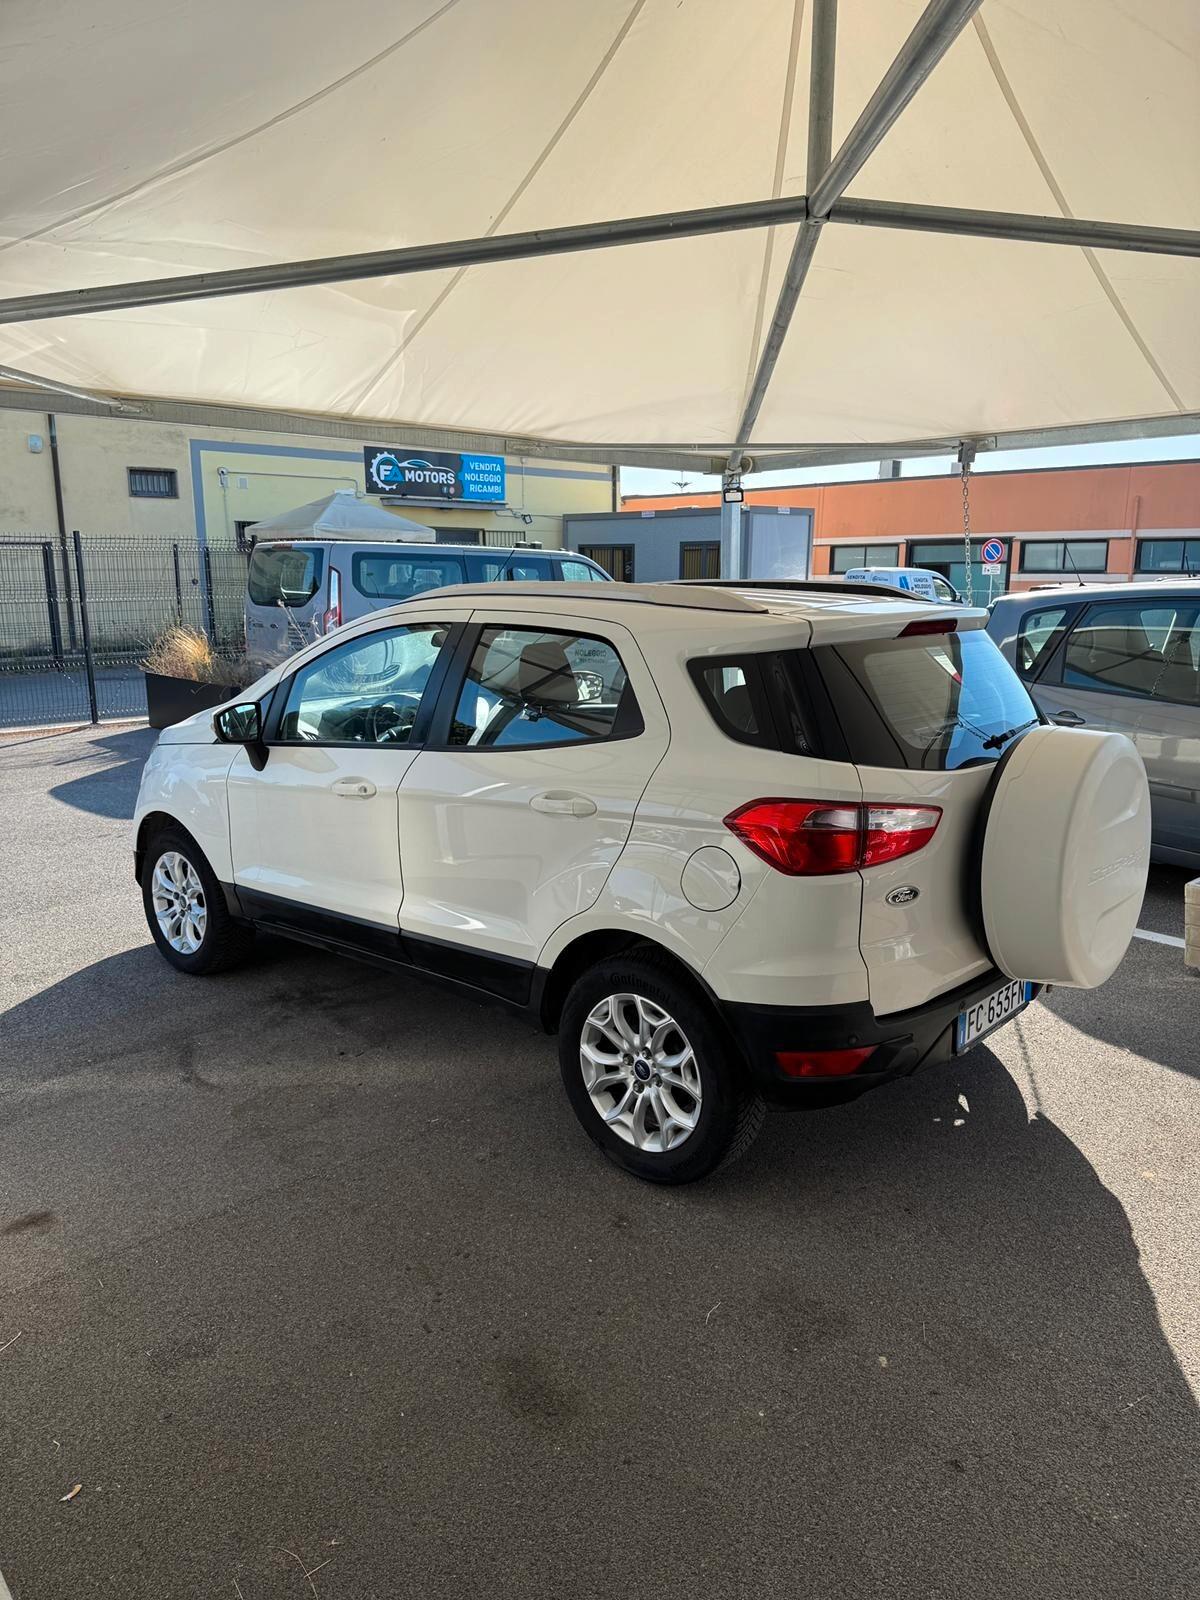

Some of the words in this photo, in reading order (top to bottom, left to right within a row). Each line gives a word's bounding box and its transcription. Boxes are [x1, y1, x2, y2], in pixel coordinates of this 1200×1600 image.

[469, 461, 501, 472] VENDITA
[405, 469, 455, 485] MOTORS
[464, 473, 501, 483] NOLEGGIO
[469, 484, 502, 494] RICAMBI
[889, 887, 917, 903] Ford
[967, 1004, 984, 1040] FC
[988, 980, 1024, 1023] 653FN
